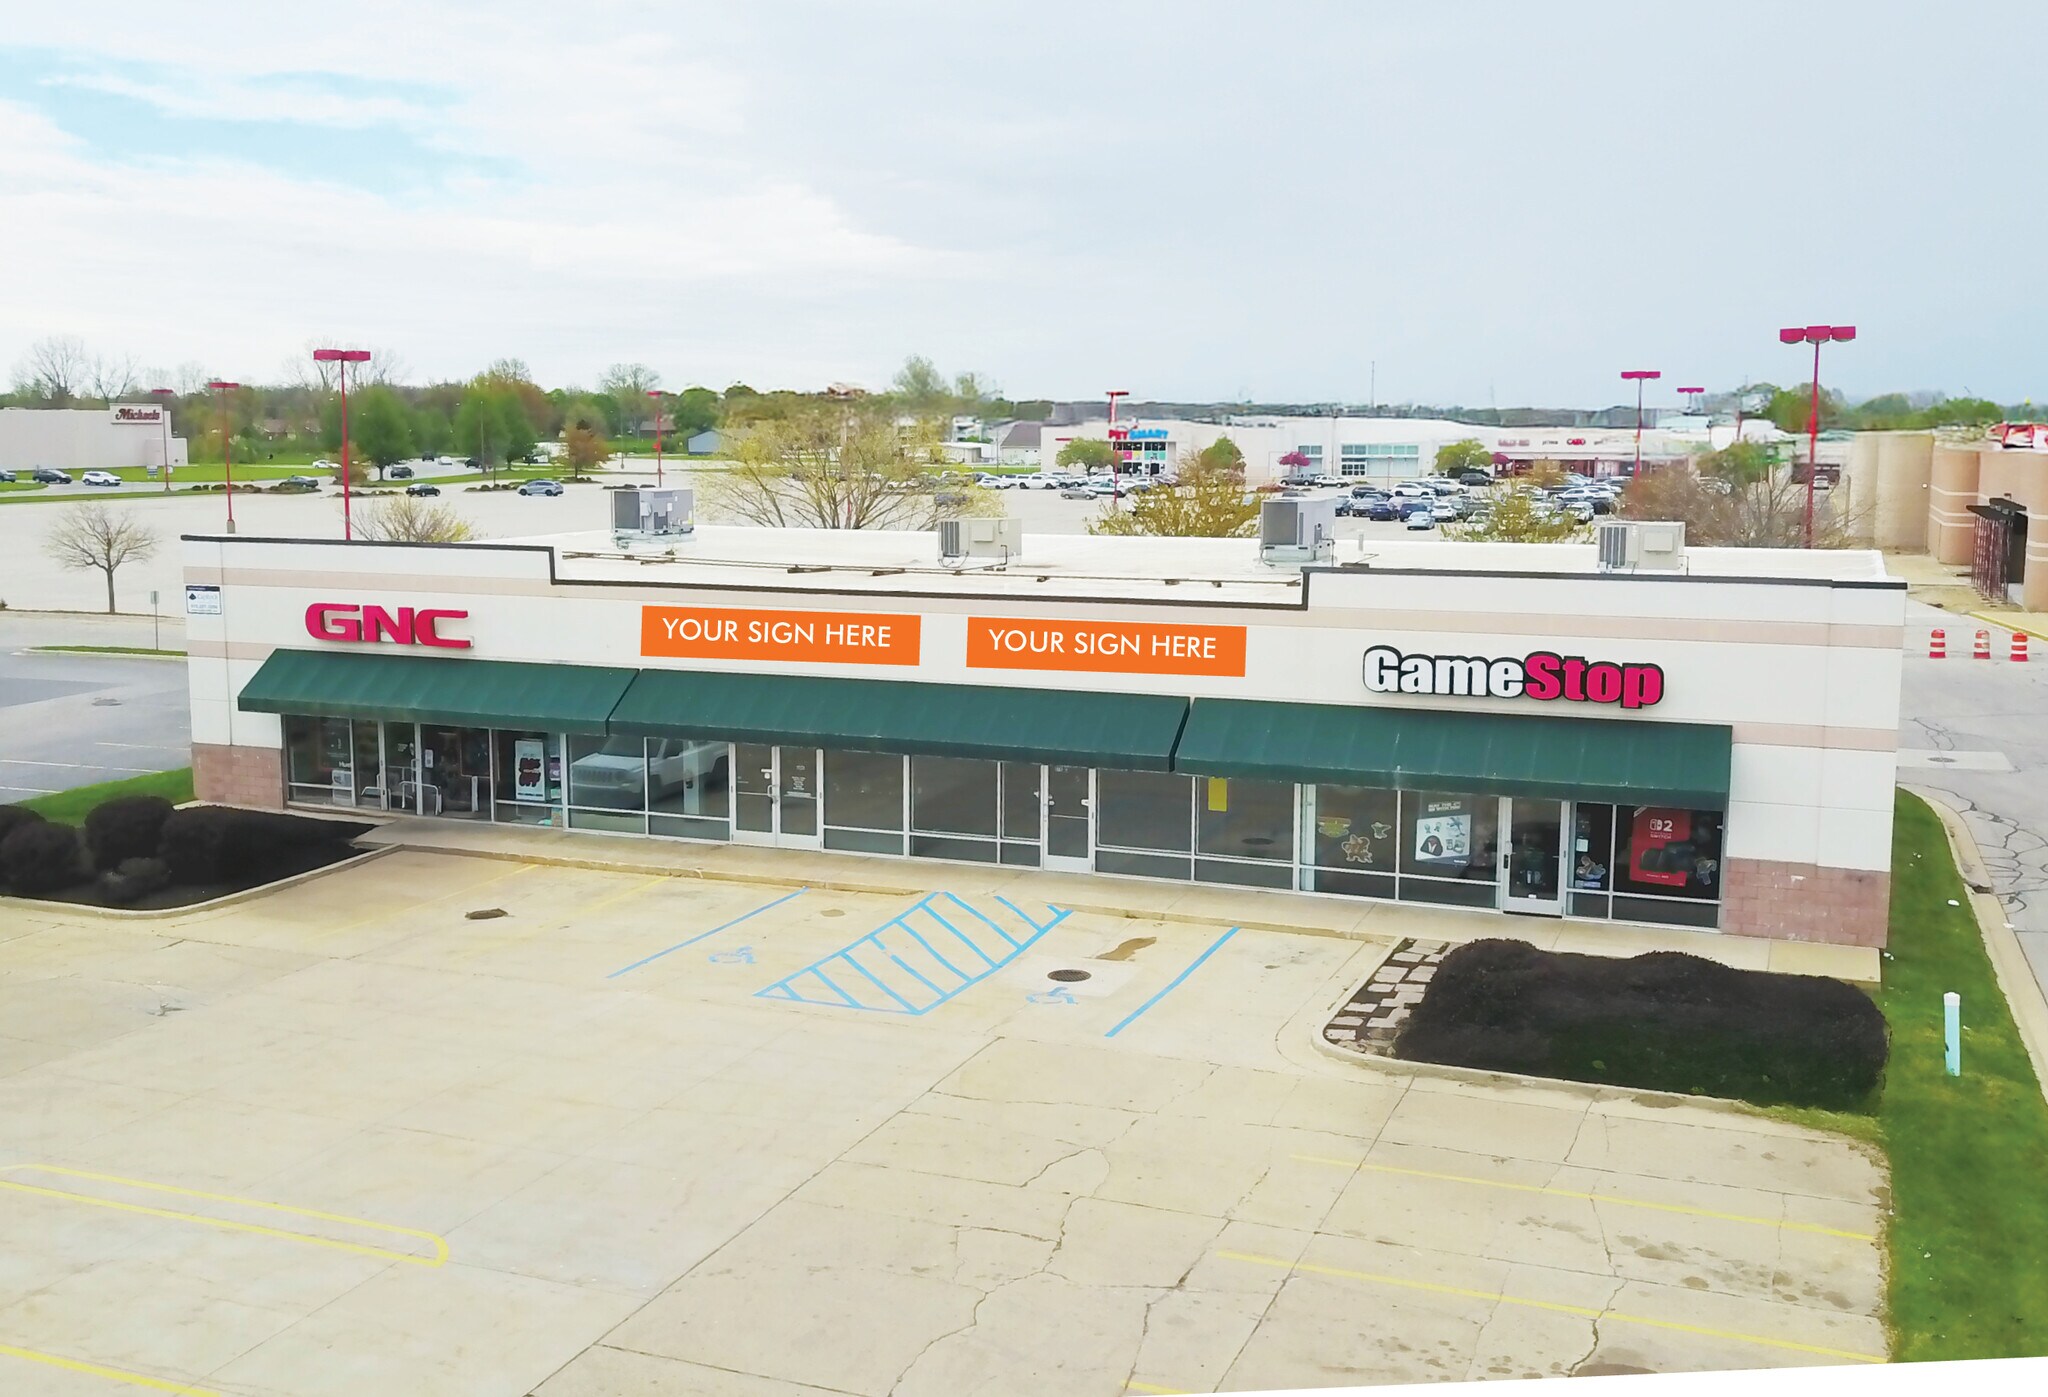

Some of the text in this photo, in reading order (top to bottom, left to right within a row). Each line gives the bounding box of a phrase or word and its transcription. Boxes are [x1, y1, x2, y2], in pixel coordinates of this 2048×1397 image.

[305, 603, 473, 649] GNC
[662, 617, 892, 648] YOUR SIGN HERE
[988, 629, 1217, 659] YOUR SIGN HERE
[1363, 645, 1665, 709] GameStop
[1663, 820, 1673, 832] 2
